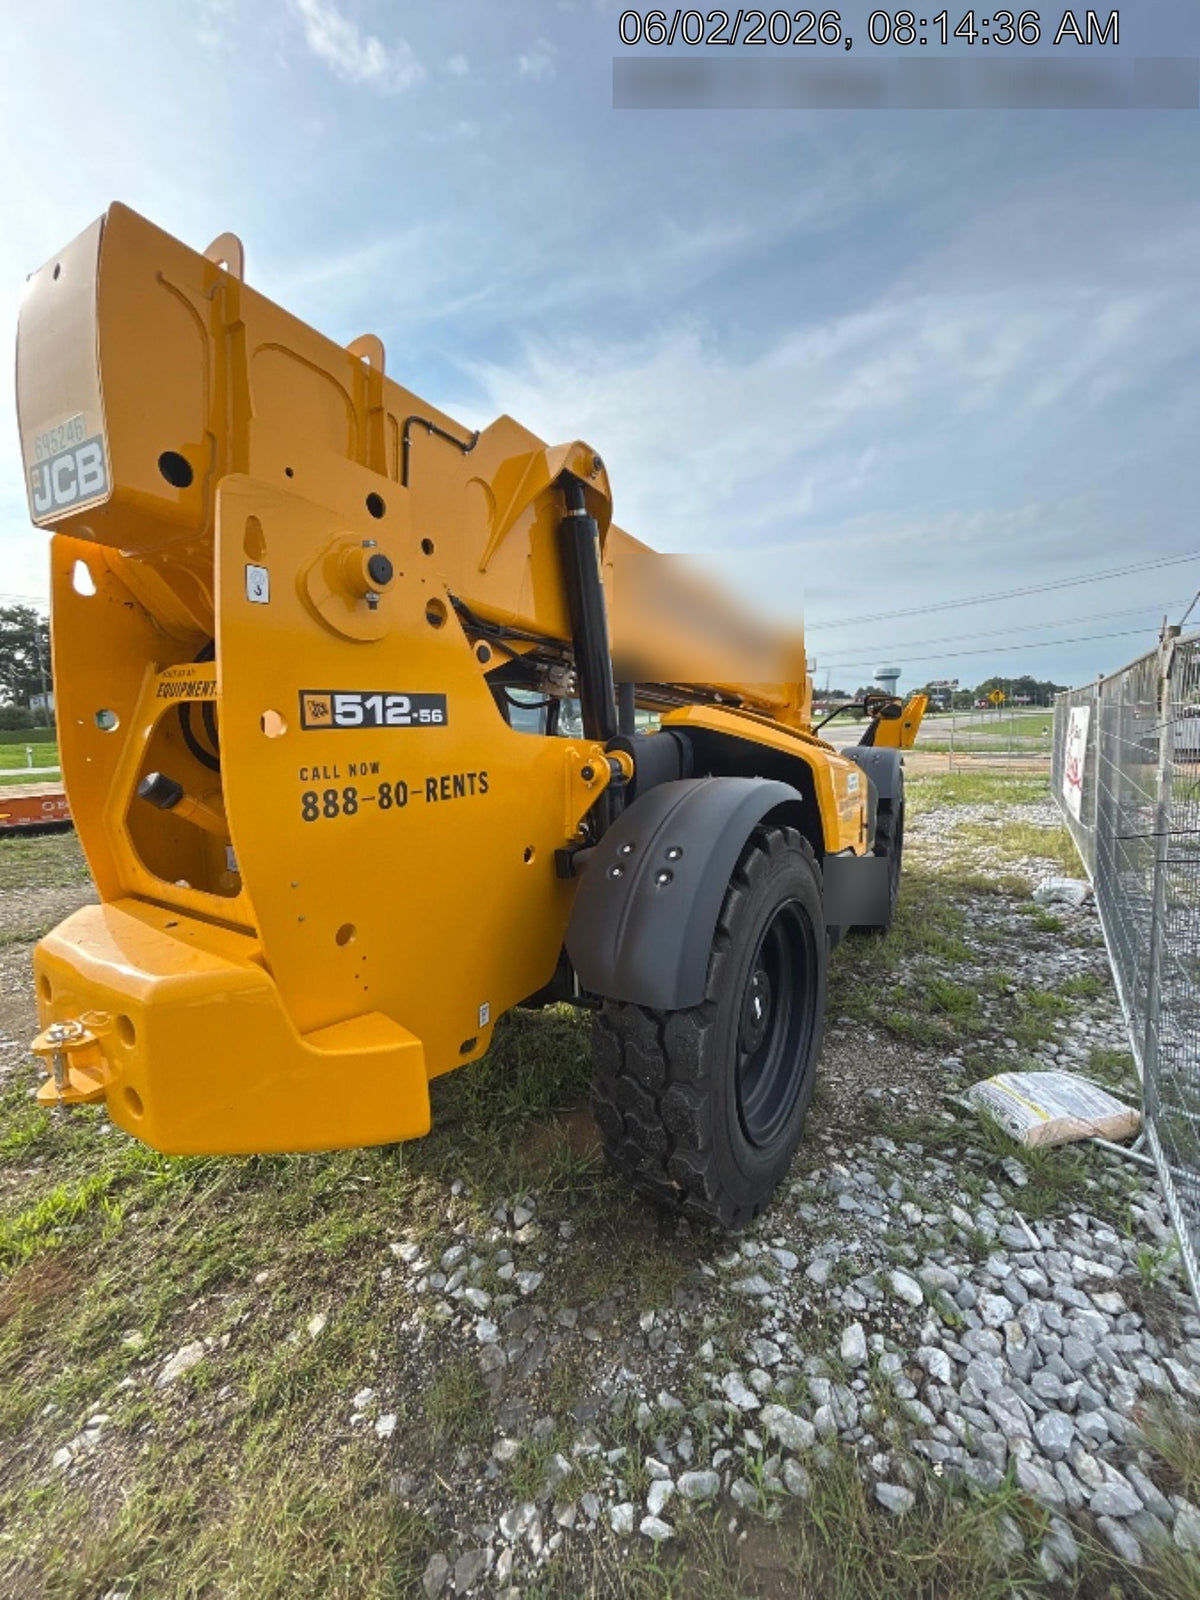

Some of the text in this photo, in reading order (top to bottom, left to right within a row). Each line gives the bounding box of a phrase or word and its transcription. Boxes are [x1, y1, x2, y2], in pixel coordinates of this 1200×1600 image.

[34, 442, 105, 512] JCB
[156, 680, 218, 699] EQUIPMENT
[300, 761, 380, 781] CALL NOW
[301, 771, 489, 822] 888-80-RENTS
